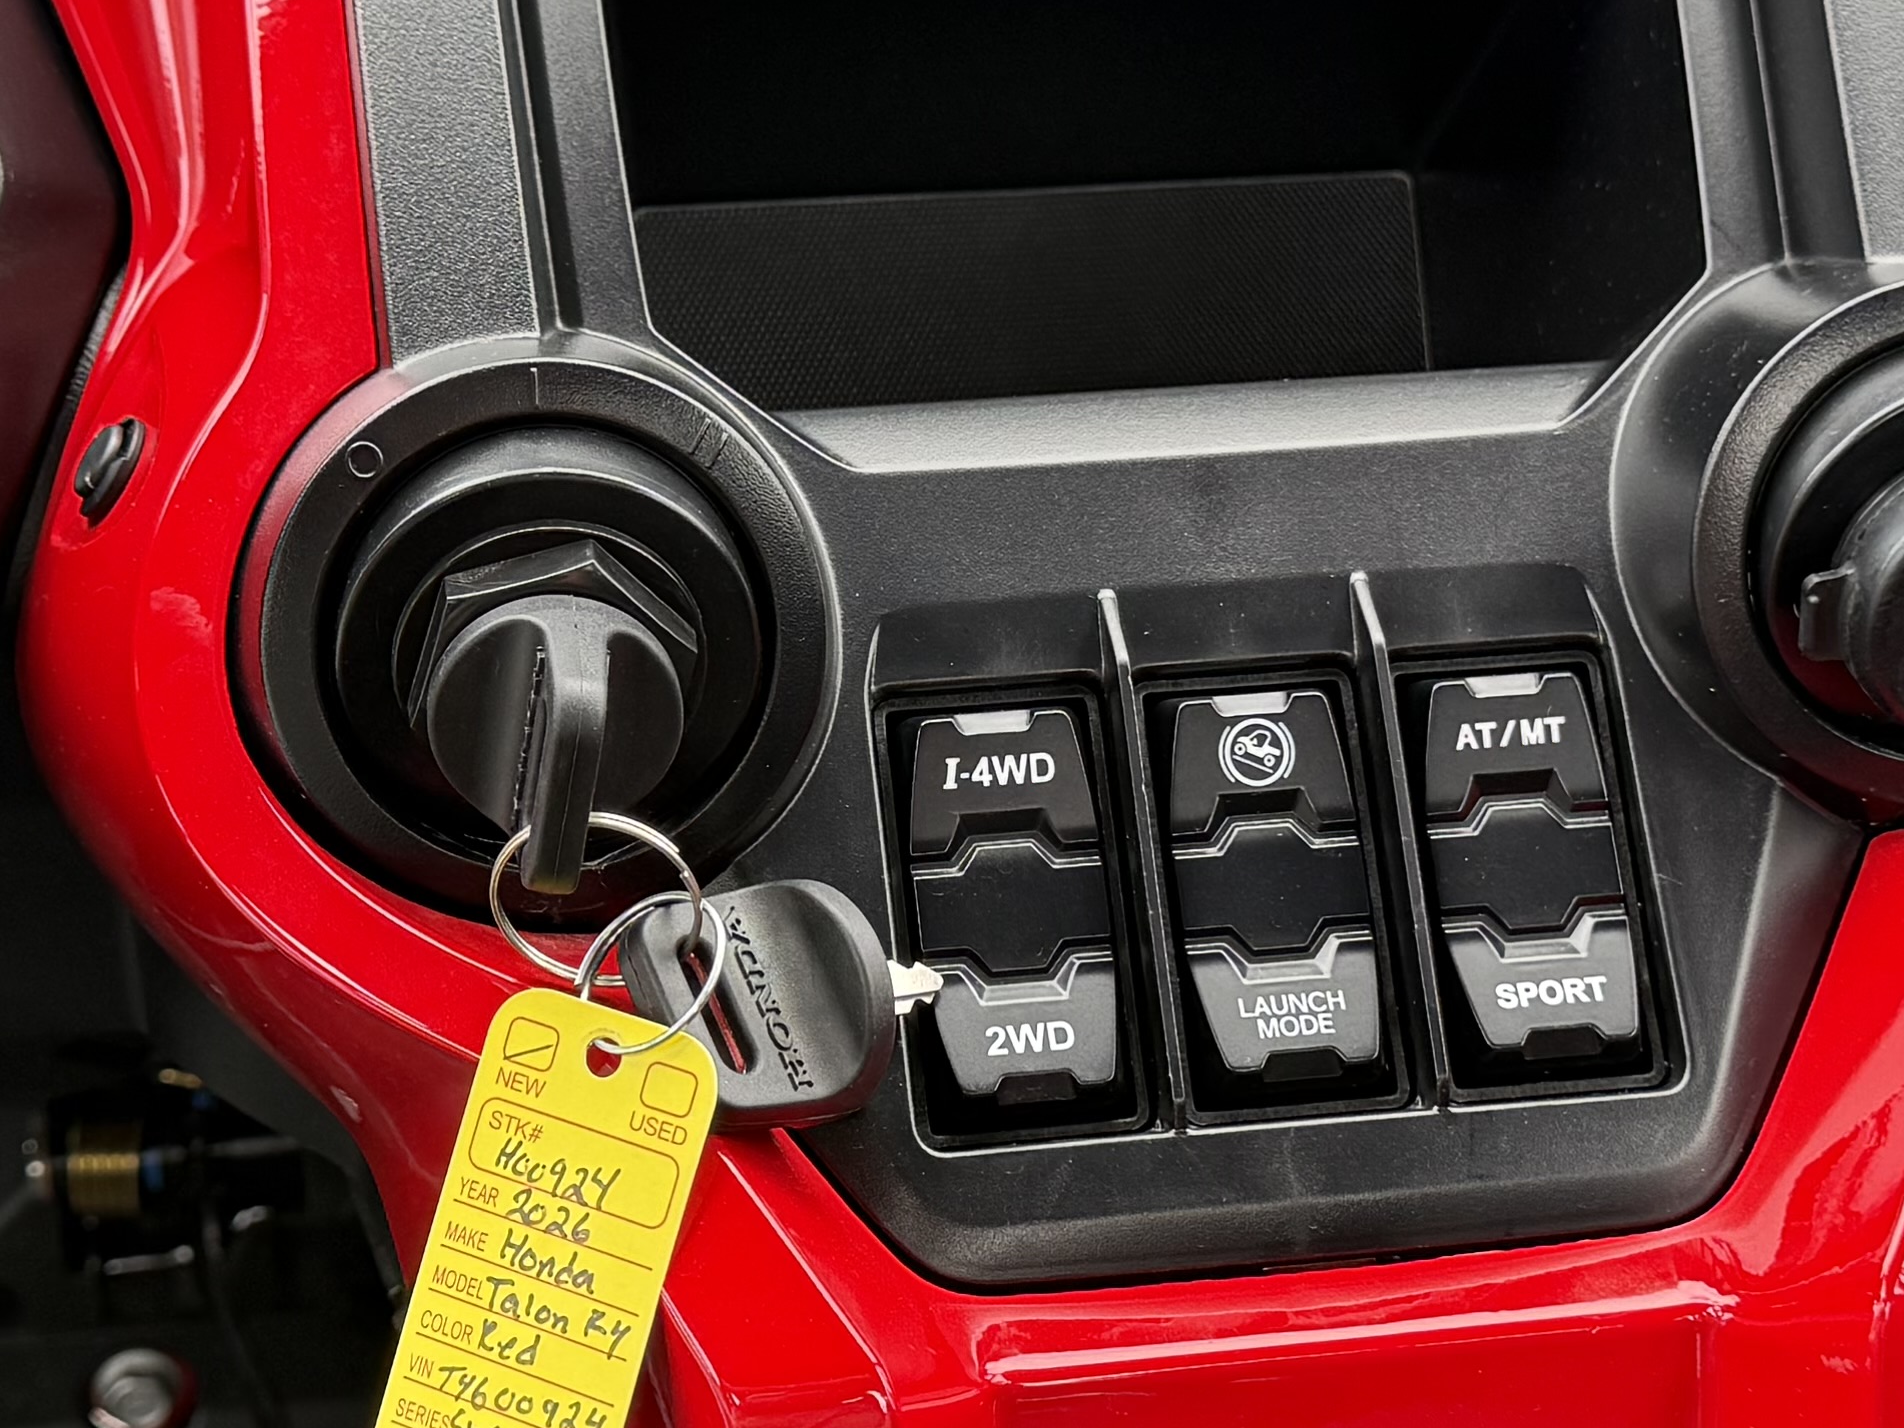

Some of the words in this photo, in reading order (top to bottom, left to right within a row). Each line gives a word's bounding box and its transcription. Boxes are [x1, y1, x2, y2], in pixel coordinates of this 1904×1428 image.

[943, 752, 1056, 790] I-4WD
[724, 906, 814, 1092] HONDA
[1237, 989, 1347, 1019] LAUNCH
[1495, 975, 1607, 1010] SPORT
[985, 1020, 1075, 1057] 2WD
[1256, 1013, 1336, 1040] MODE
[496, 1067, 546, 1098] NEW
[488, 1110, 544, 1143] STK#
[629, 1110, 688, 1146] USED
[460, 1177, 500, 1207] YEAR
[506, 1188, 590, 1244] 2026
[445, 1221, 489, 1252] MAKE
[500, 1228, 595, 1295] Honda
[432, 1265, 484, 1300] MODEL
[486, 1275, 569, 1334] Talon
[420, 1310, 474, 1345] COLOR
[477, 1318, 541, 1365] Red
[409, 1352, 435, 1379] VIN
